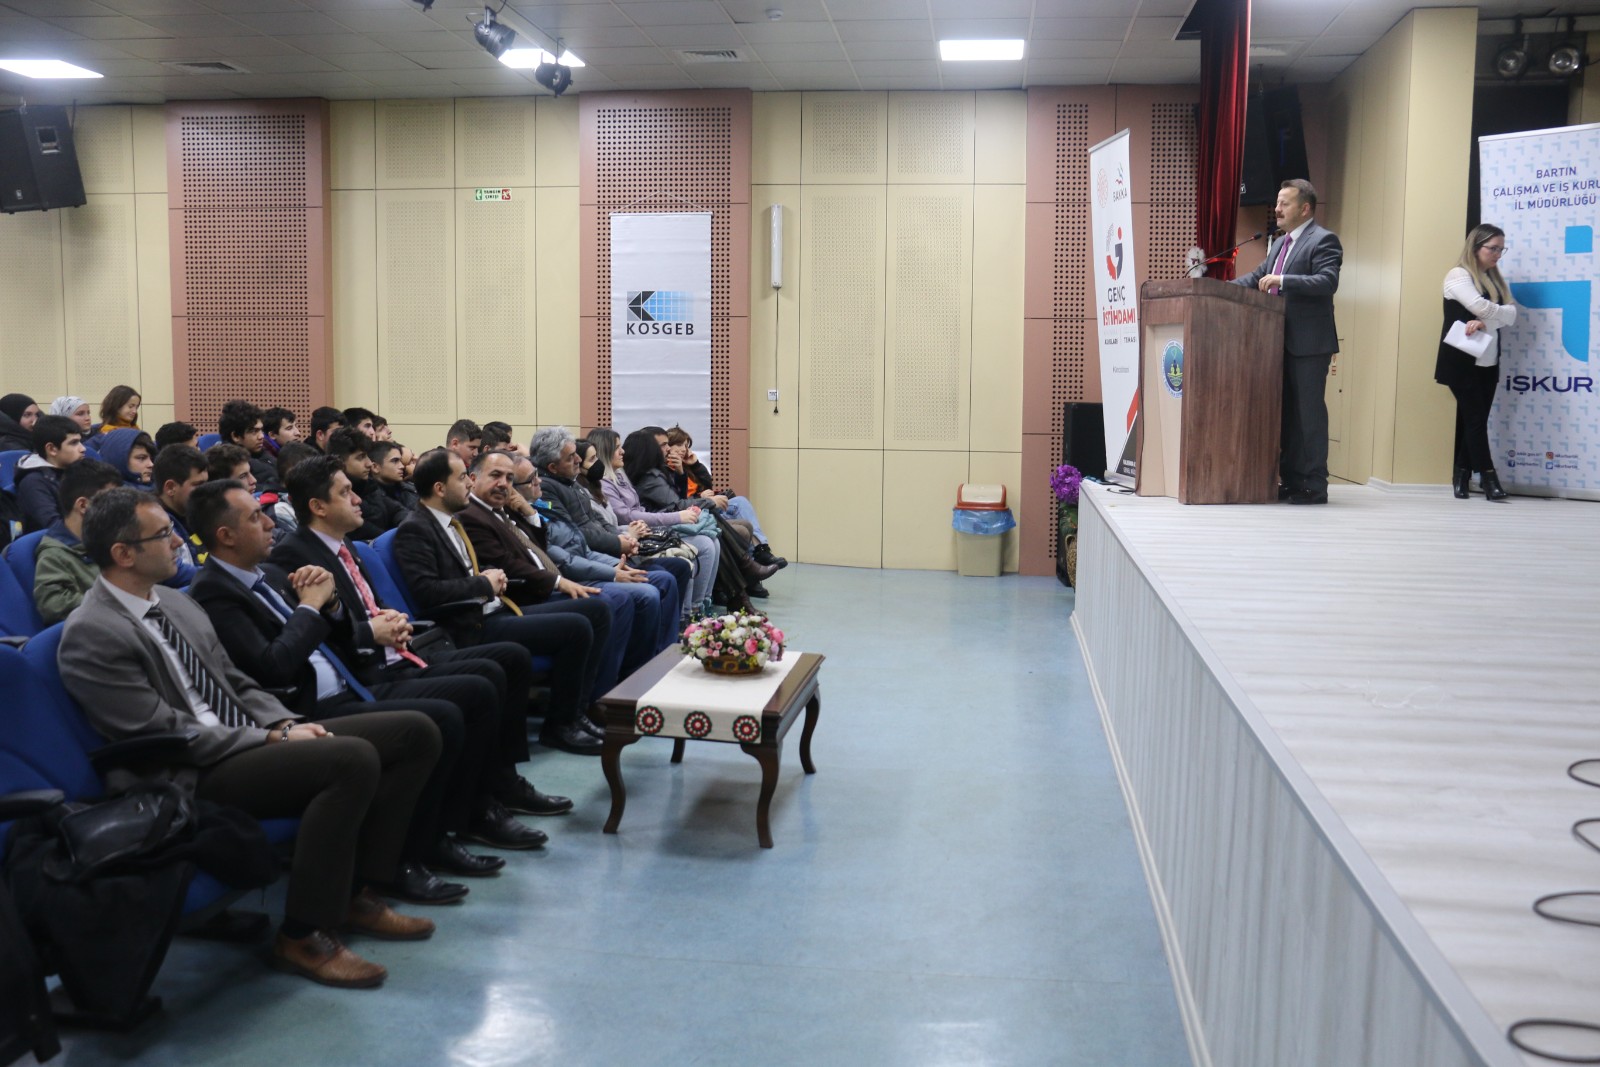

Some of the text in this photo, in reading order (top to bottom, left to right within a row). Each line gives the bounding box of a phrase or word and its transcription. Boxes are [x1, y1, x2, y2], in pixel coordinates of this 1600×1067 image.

[1536, 166, 1577, 179] BARTIN
[1493, 185, 1540, 199] ÇALIŞMA
[1542, 183, 1556, 193] VE
[1559, 180, 1569, 194] İŞ
[1514, 193, 1597, 210] İL MÜDÜRLÜĞÜ
[1107, 285, 1126, 305] GENÇ
[1102, 305, 1136, 326] İSTİHDAMI
[626, 322, 694, 336] KOSGEB
